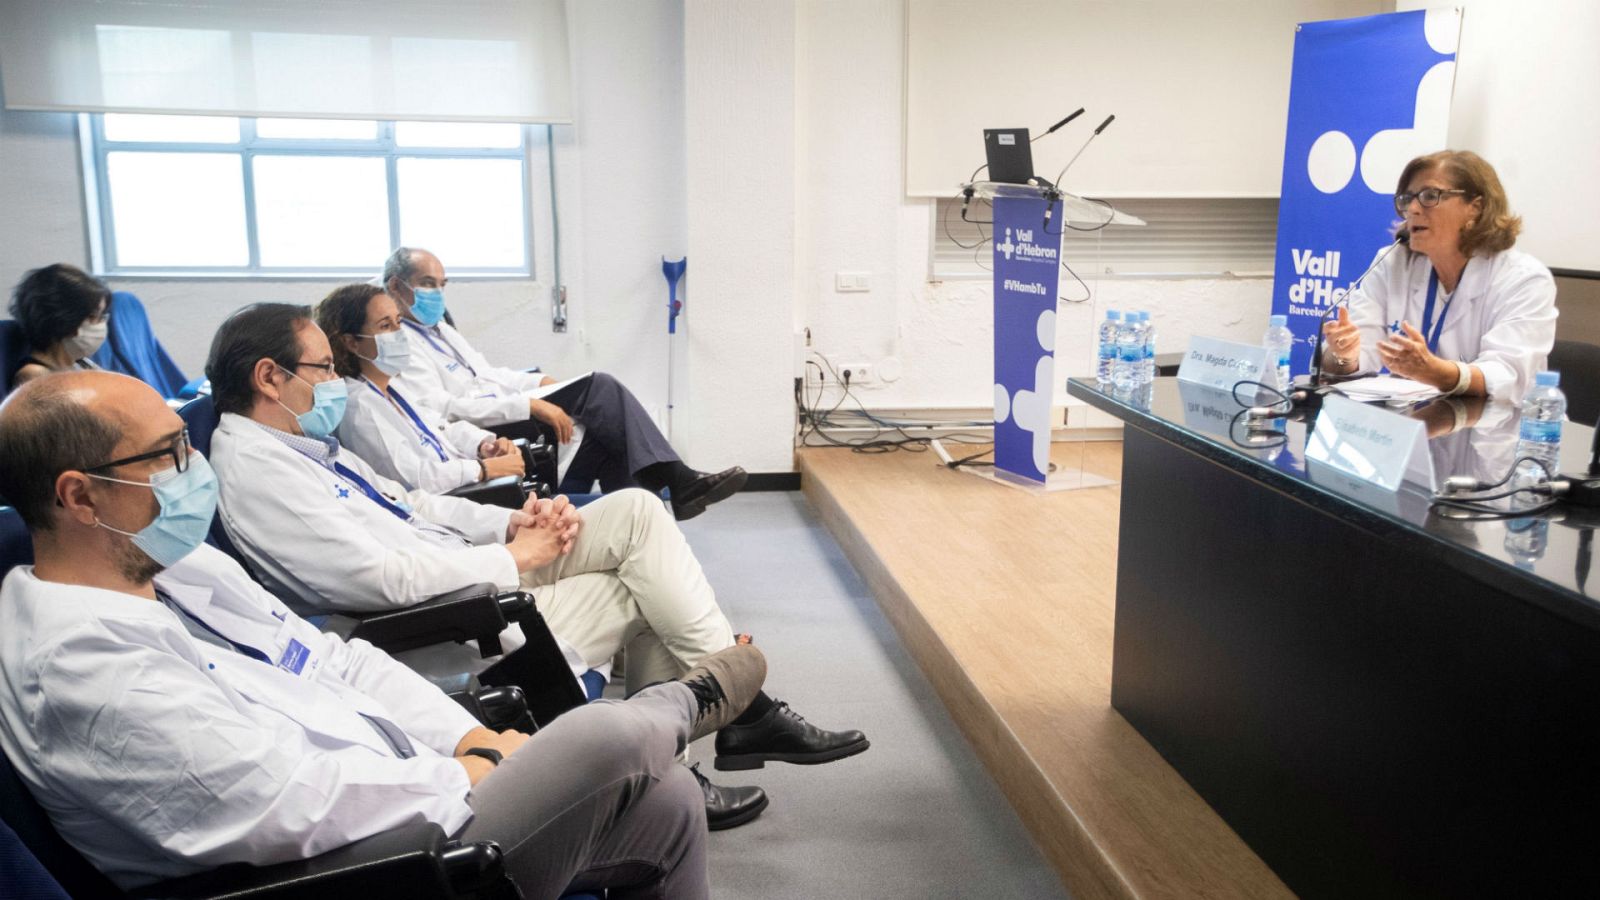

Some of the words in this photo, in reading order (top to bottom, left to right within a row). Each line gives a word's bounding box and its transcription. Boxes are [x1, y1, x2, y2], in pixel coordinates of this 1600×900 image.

[1016, 229, 1033, 242] Vall
[1015, 242, 1057, 259] d'Hebron
[1291, 248, 1341, 278] Vall
[1004, 280, 1047, 295] #VHambTu
